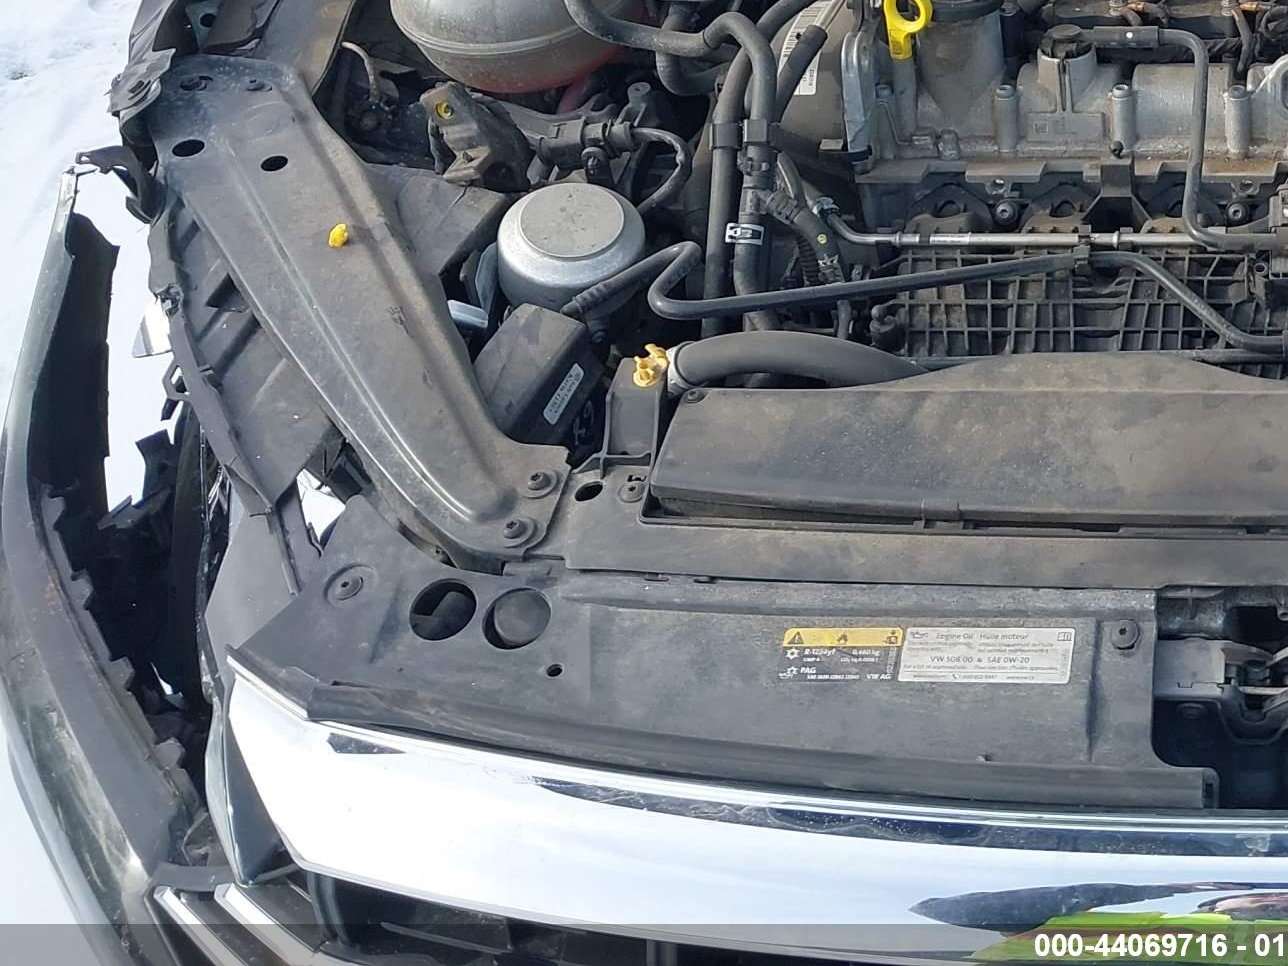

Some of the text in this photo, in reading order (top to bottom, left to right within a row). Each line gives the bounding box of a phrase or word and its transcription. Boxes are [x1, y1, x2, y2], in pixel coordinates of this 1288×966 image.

[936, 633, 960, 641] Engine
[930, 655, 945, 663] VW
[1003, 656, 1031, 664] 0W-20
[800, 666, 817, 674] PAG
